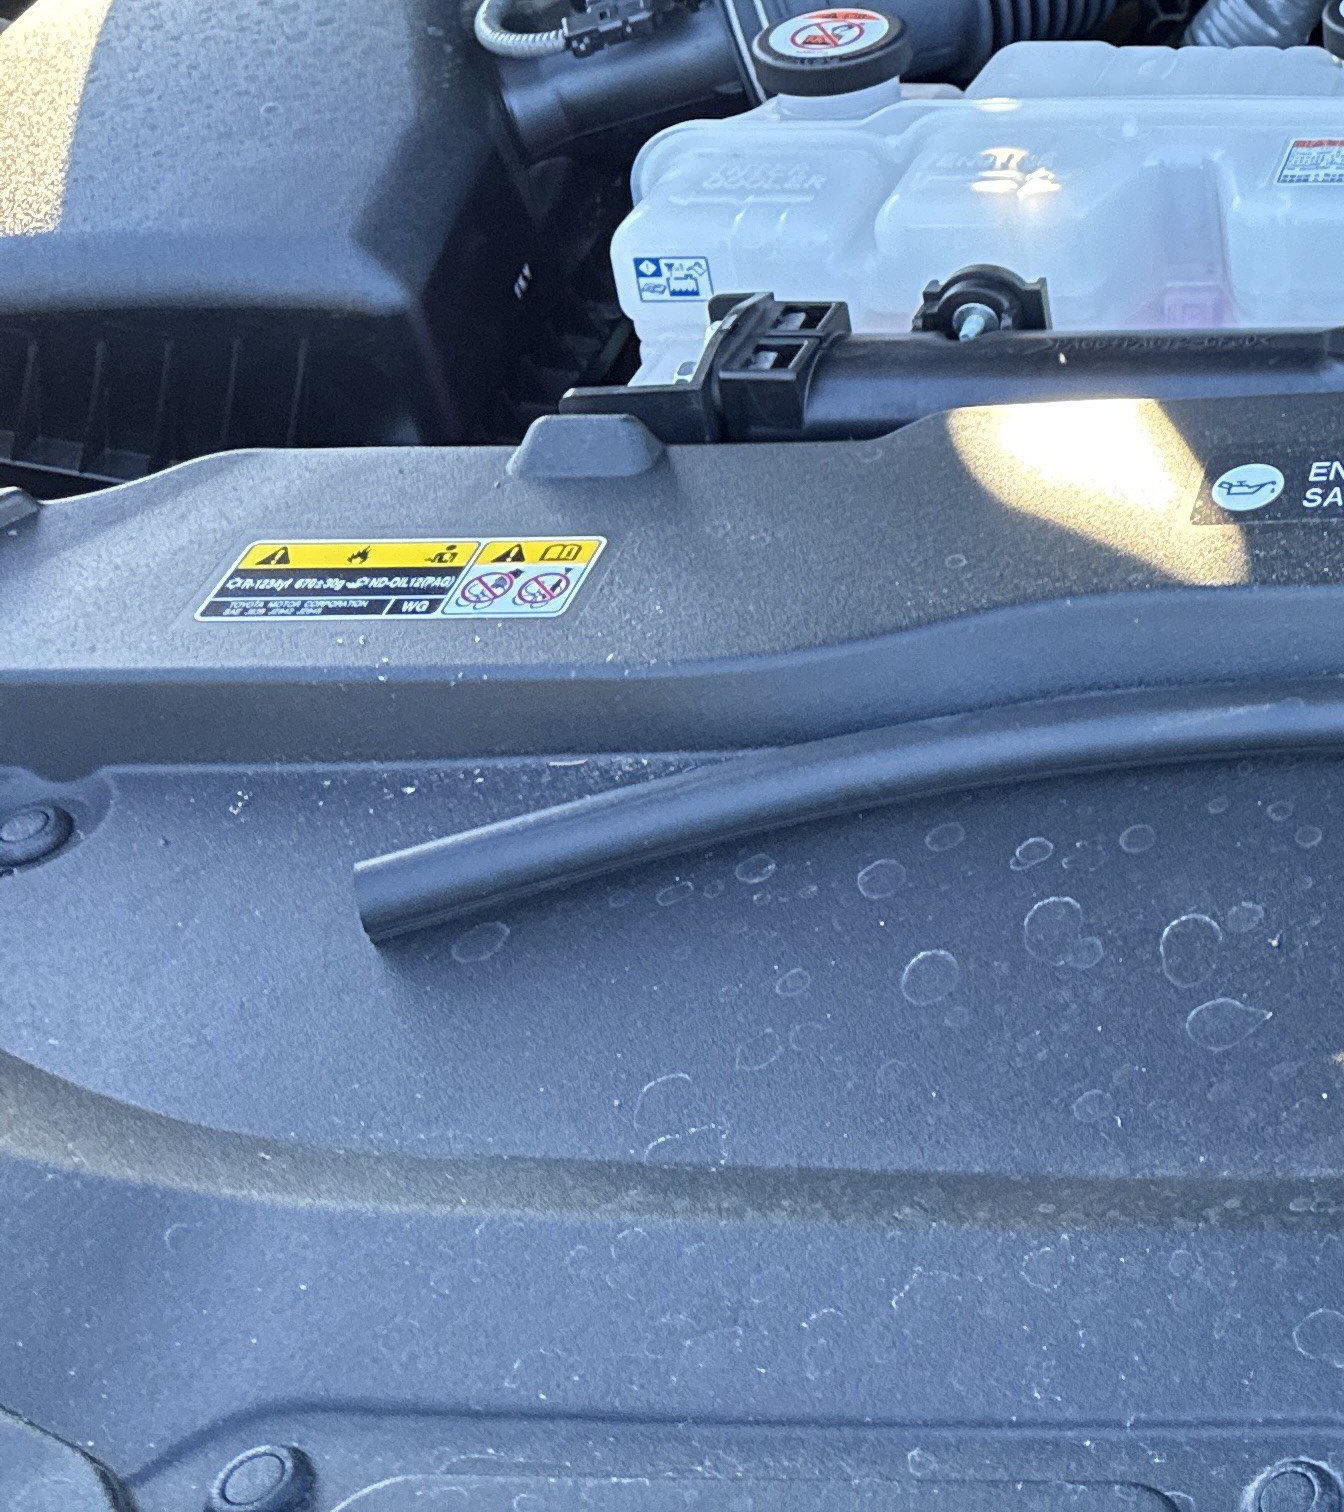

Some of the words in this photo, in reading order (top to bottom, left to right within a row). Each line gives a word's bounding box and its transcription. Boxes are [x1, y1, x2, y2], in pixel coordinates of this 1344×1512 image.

[229, 600, 265, 609] TOYOTA
[267, 600, 302, 609] MOTOR
[303, 599, 369, 609] CORPORATION
[401, 600, 430, 613] WG
